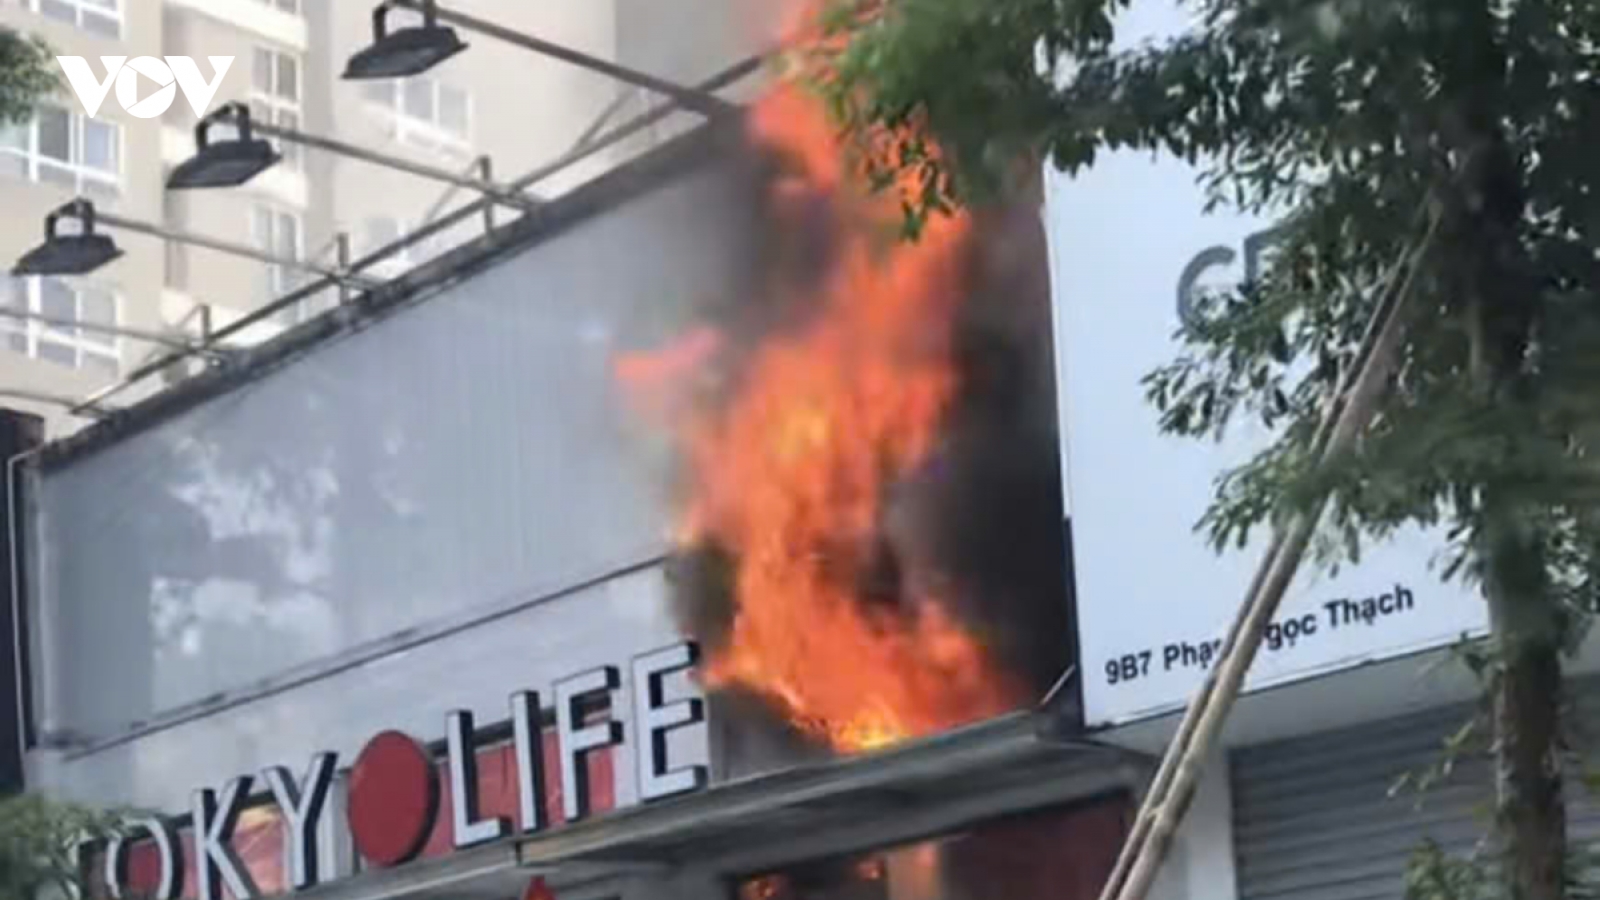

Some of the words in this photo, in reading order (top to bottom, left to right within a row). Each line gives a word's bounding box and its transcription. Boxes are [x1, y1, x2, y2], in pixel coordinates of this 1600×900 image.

[1104, 649, 1153, 685] 9B7
[1260, 613, 1317, 650] gọc
[1324, 583, 1414, 626] Thạch
